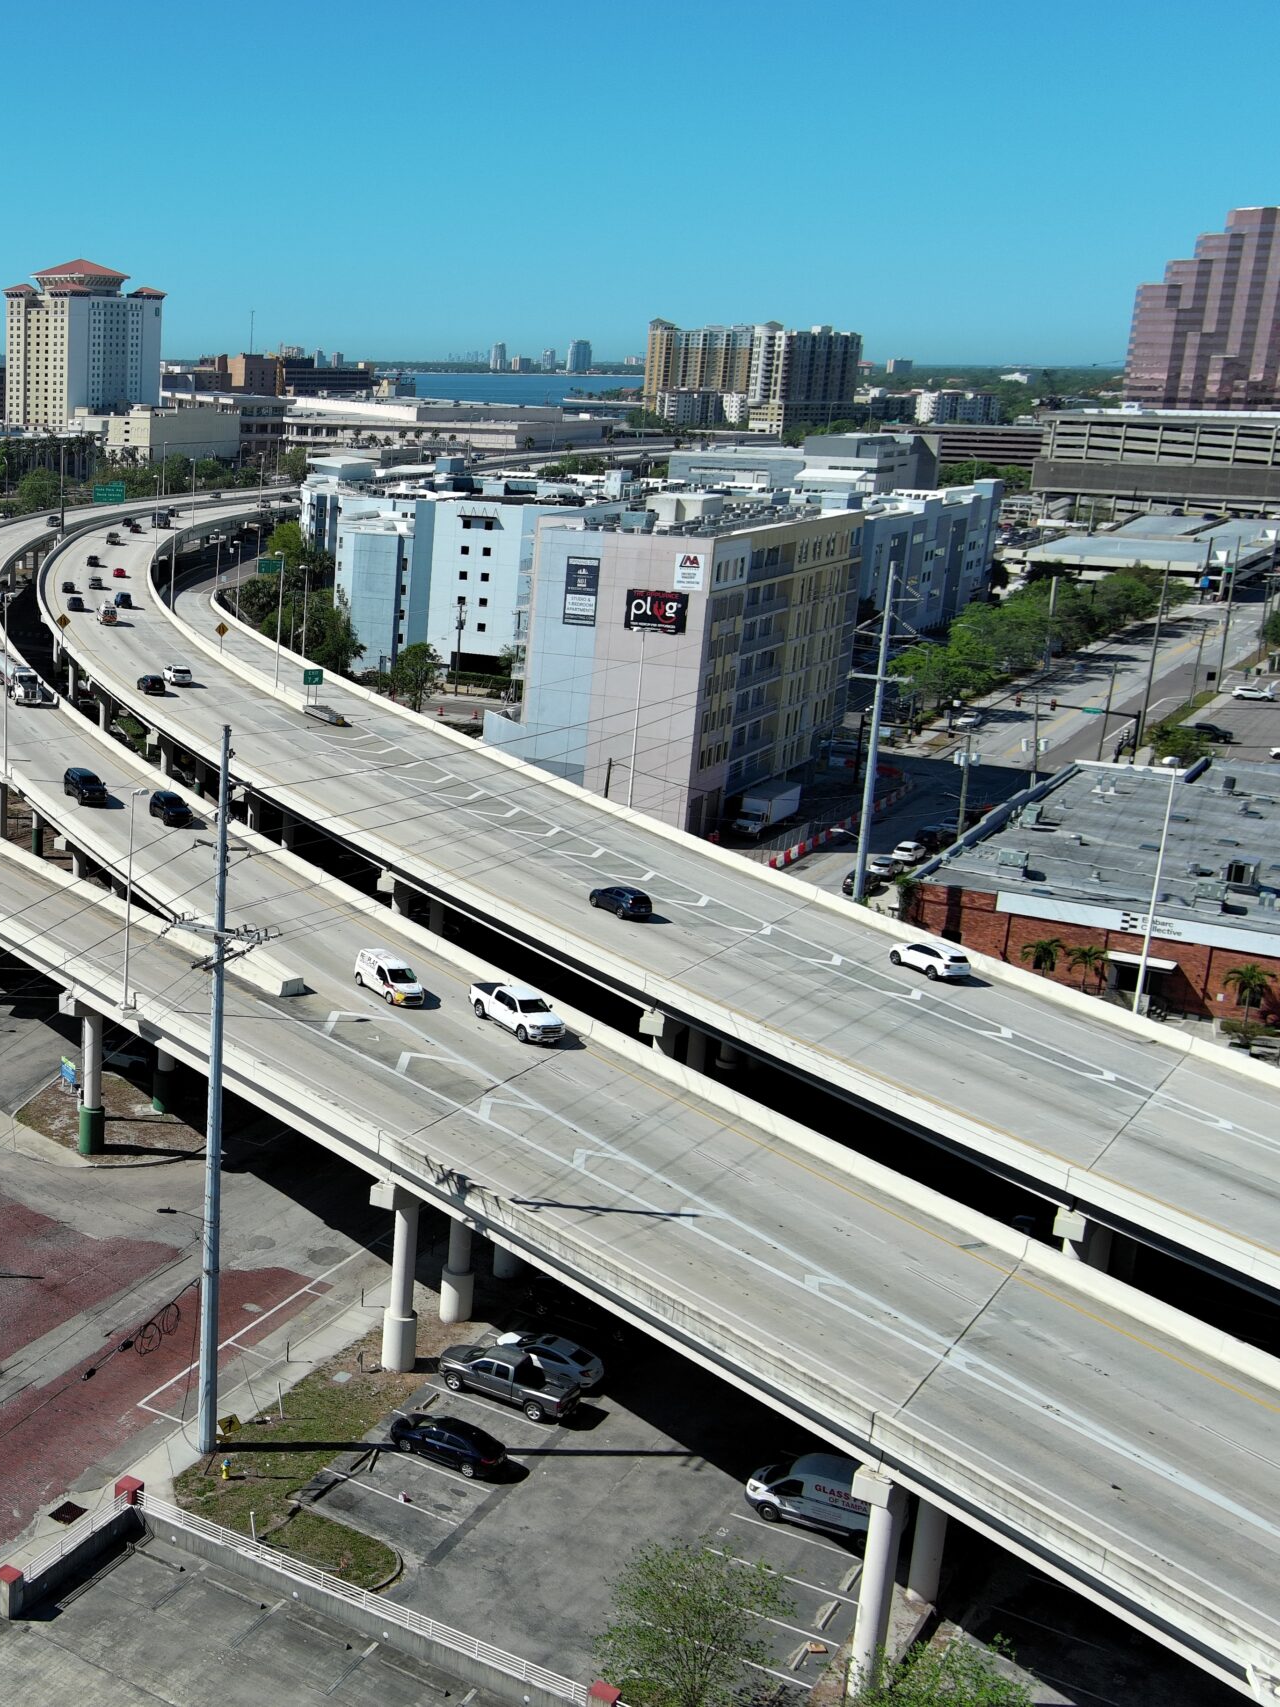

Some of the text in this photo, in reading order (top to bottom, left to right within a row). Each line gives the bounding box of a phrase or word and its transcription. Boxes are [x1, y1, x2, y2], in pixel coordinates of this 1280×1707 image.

[631, 597, 678, 623] plug
[1142, 917, 1175, 928] Ebarc
[1140, 924, 1183, 936] Cllective
[814, 1484, 851, 1501] GLASS
[842, 1500, 868, 1512] TAMPA
